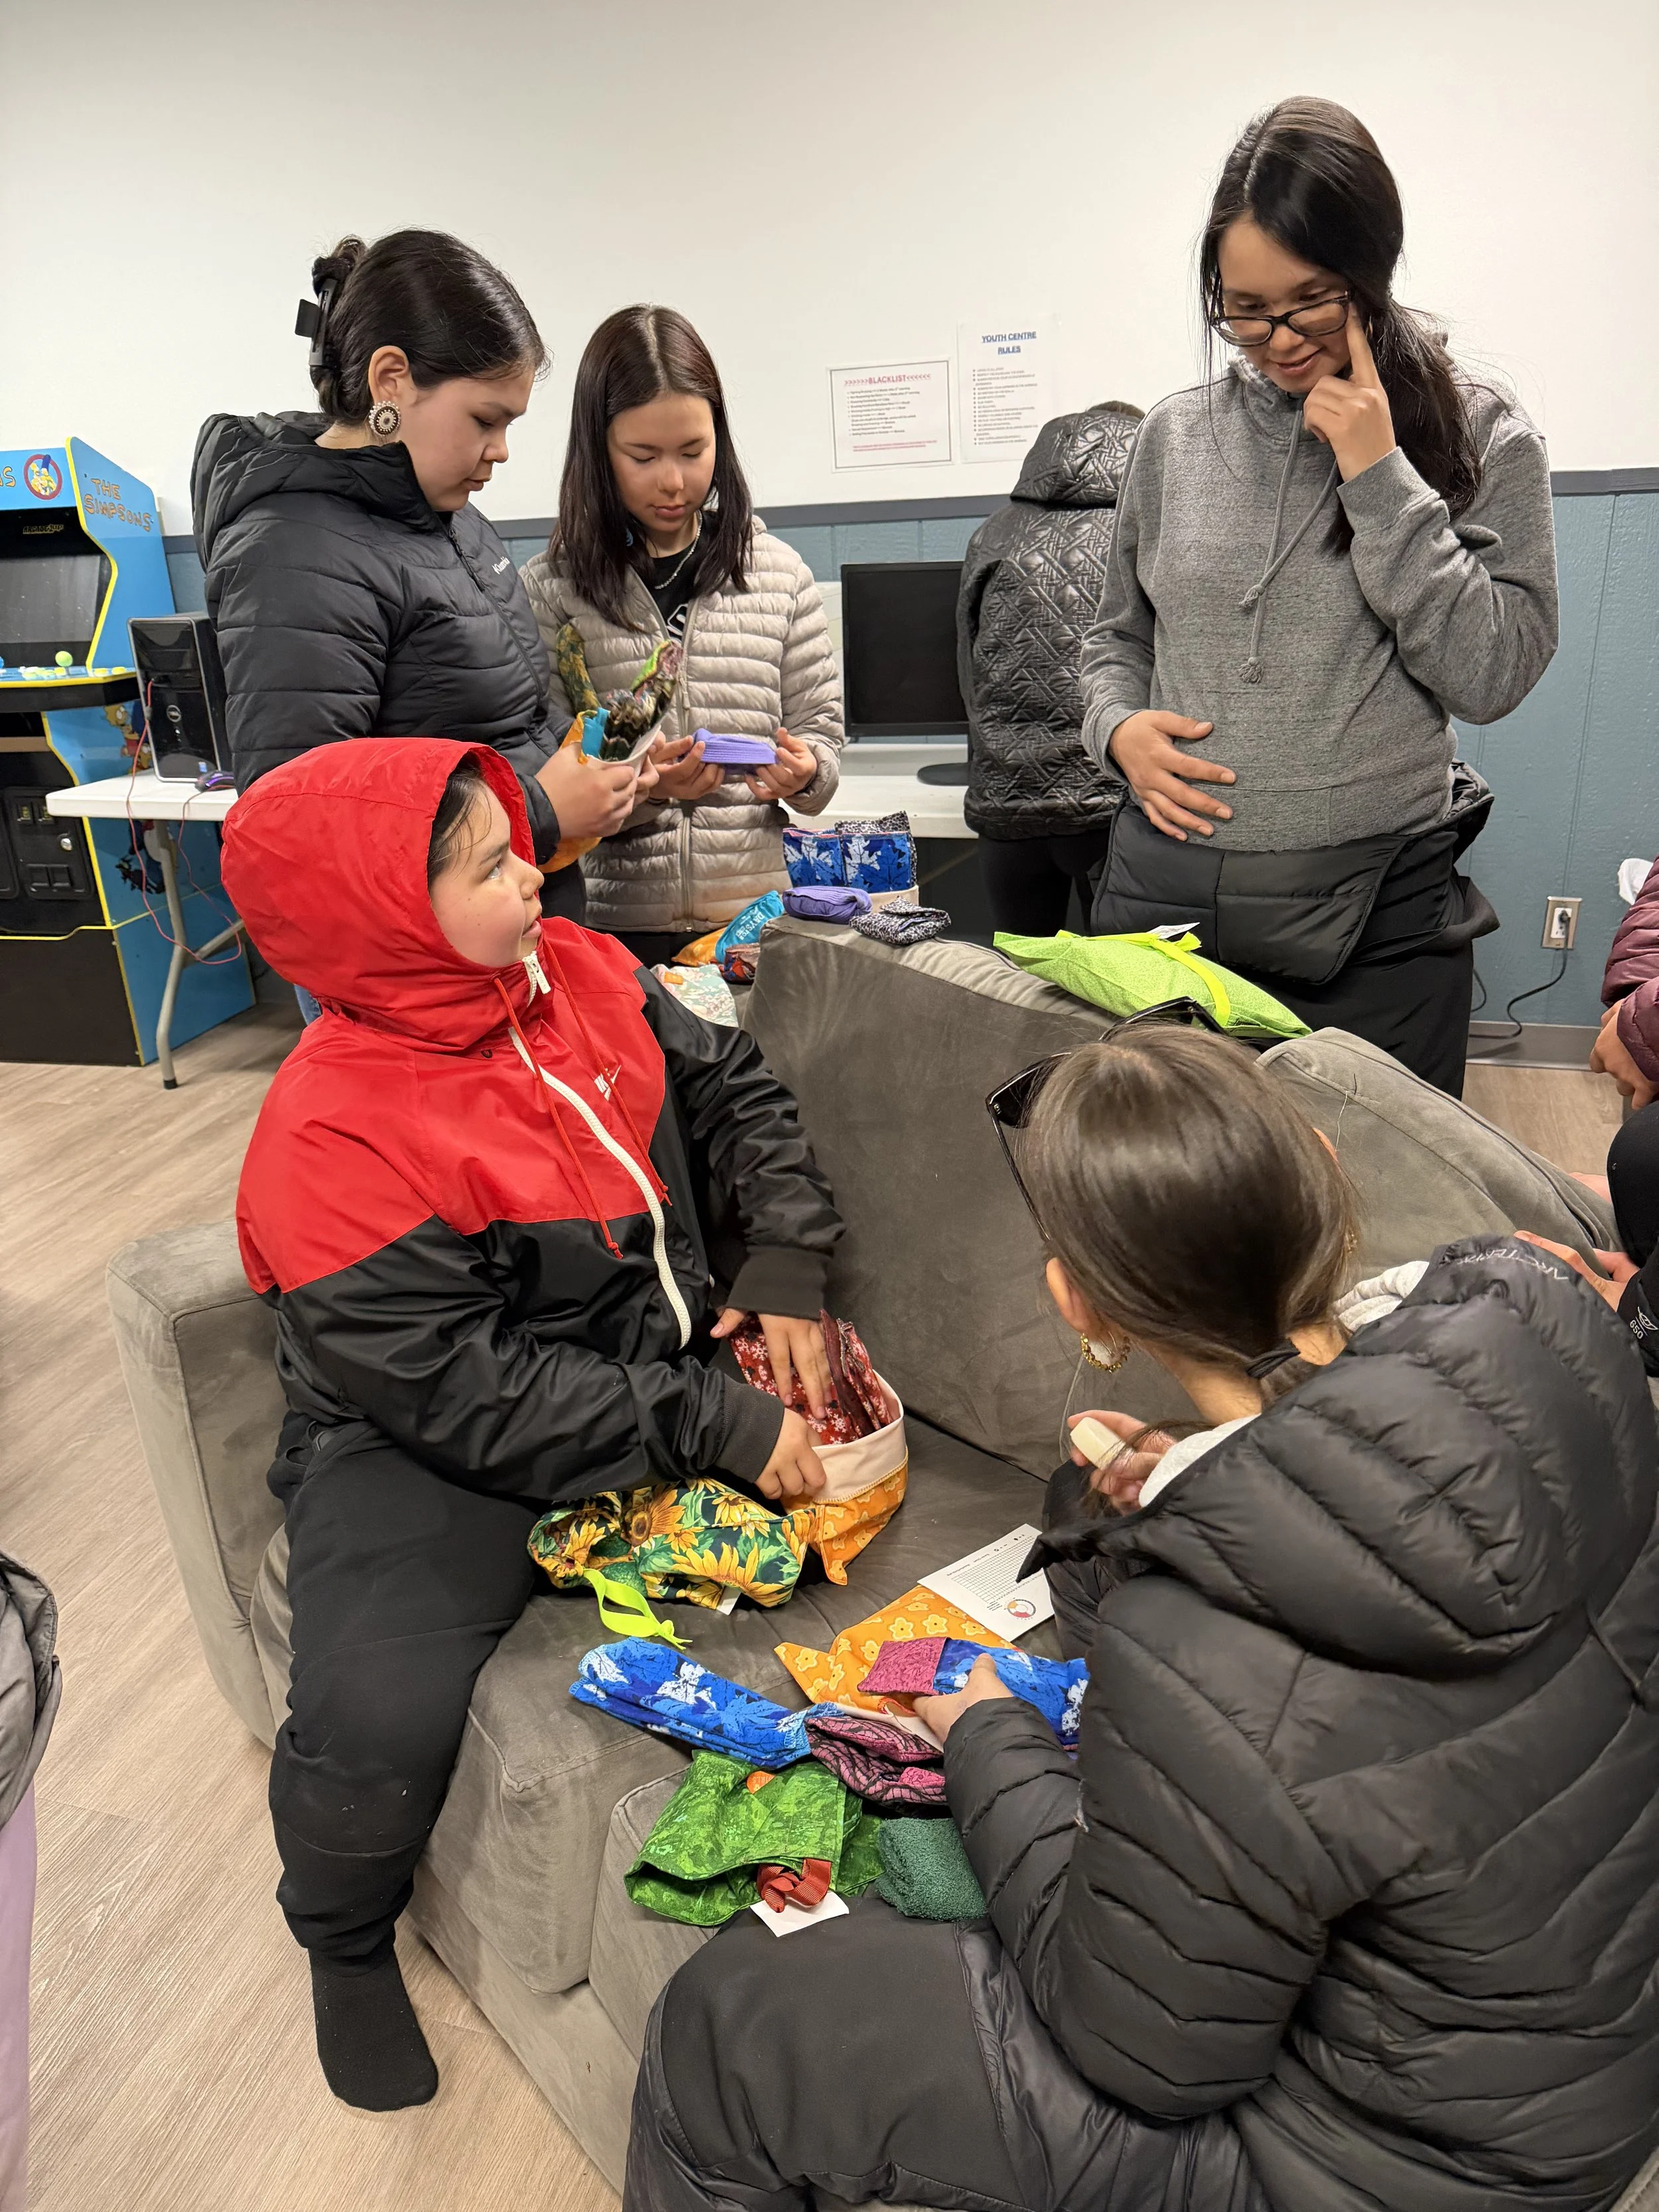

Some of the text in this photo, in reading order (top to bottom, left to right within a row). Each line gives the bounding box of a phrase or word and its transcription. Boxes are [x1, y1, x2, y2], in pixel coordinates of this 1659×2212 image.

[981, 331, 1037, 343] YOUTH CENTRE
[997, 346, 1021, 354] RULES
[91, 478, 121, 500] THE
[84, 494, 151, 532] SIMPSONS
[745, 911, 765, 931] DAYS
[1630, 1319, 1644, 1339] 650
